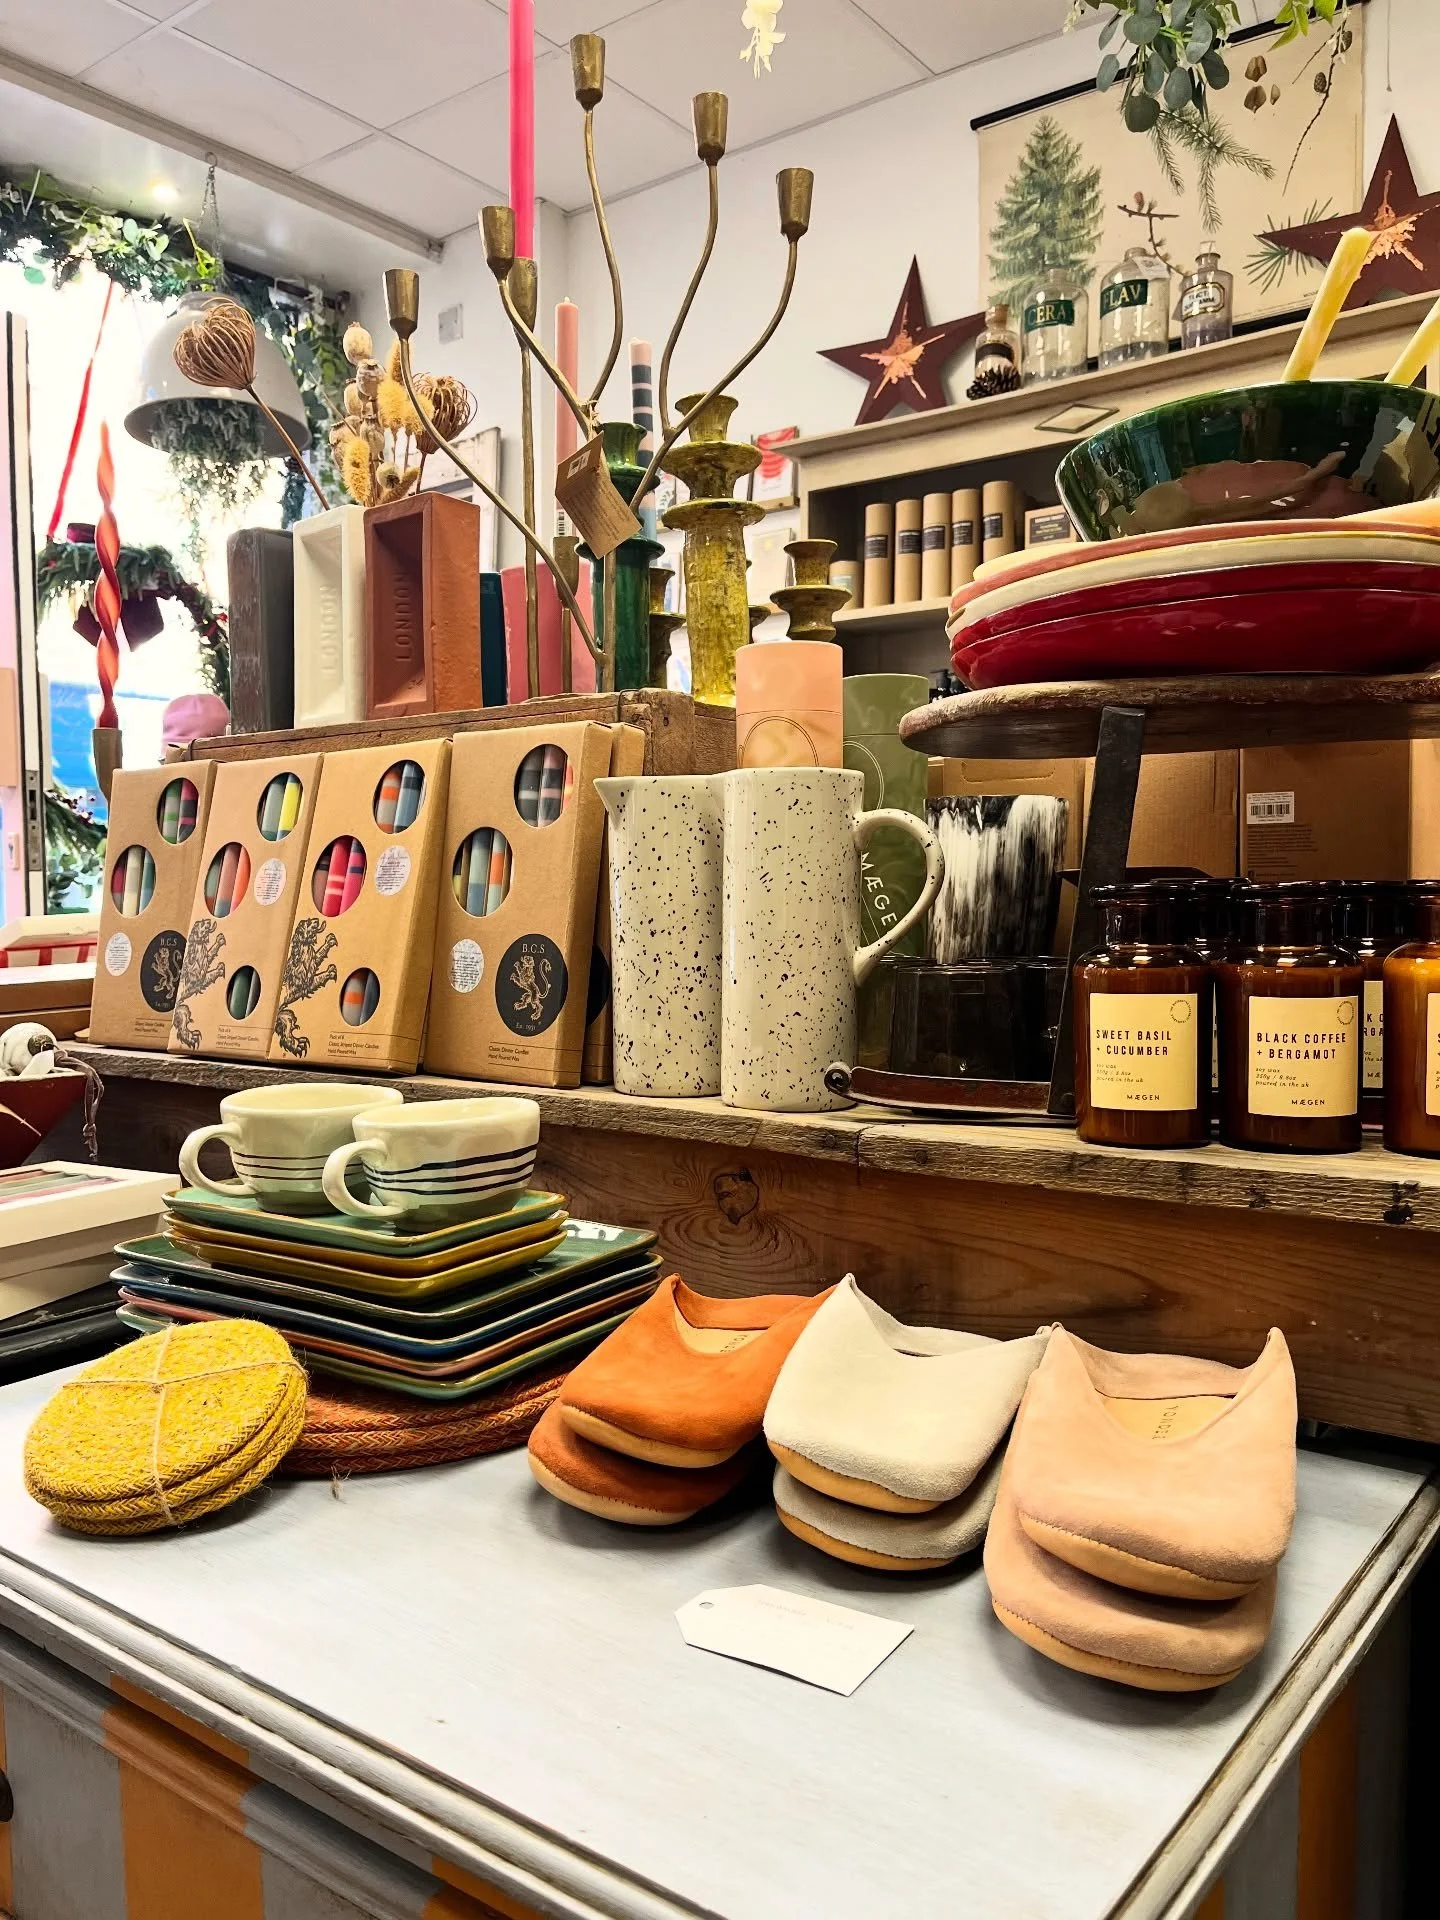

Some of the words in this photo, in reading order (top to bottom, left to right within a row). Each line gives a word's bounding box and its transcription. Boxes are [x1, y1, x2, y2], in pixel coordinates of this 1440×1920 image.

[1028, 303, 1066, 326] CERA
[394, 572, 412, 662] LONDON
[860, 850, 898, 926] MÆGE
[522, 943, 545, 954] B.C.S
[1096, 1029, 1130, 1040] SWEET
[1137, 1031, 1171, 1041] BASIL
[1256, 1032, 1298, 1043] BLACK
[1304, 1032, 1347, 1044] COFFEE
[1106, 1045, 1168, 1056] CUCUMBER
[1269, 1049, 1336, 1060] BERGAMOT
